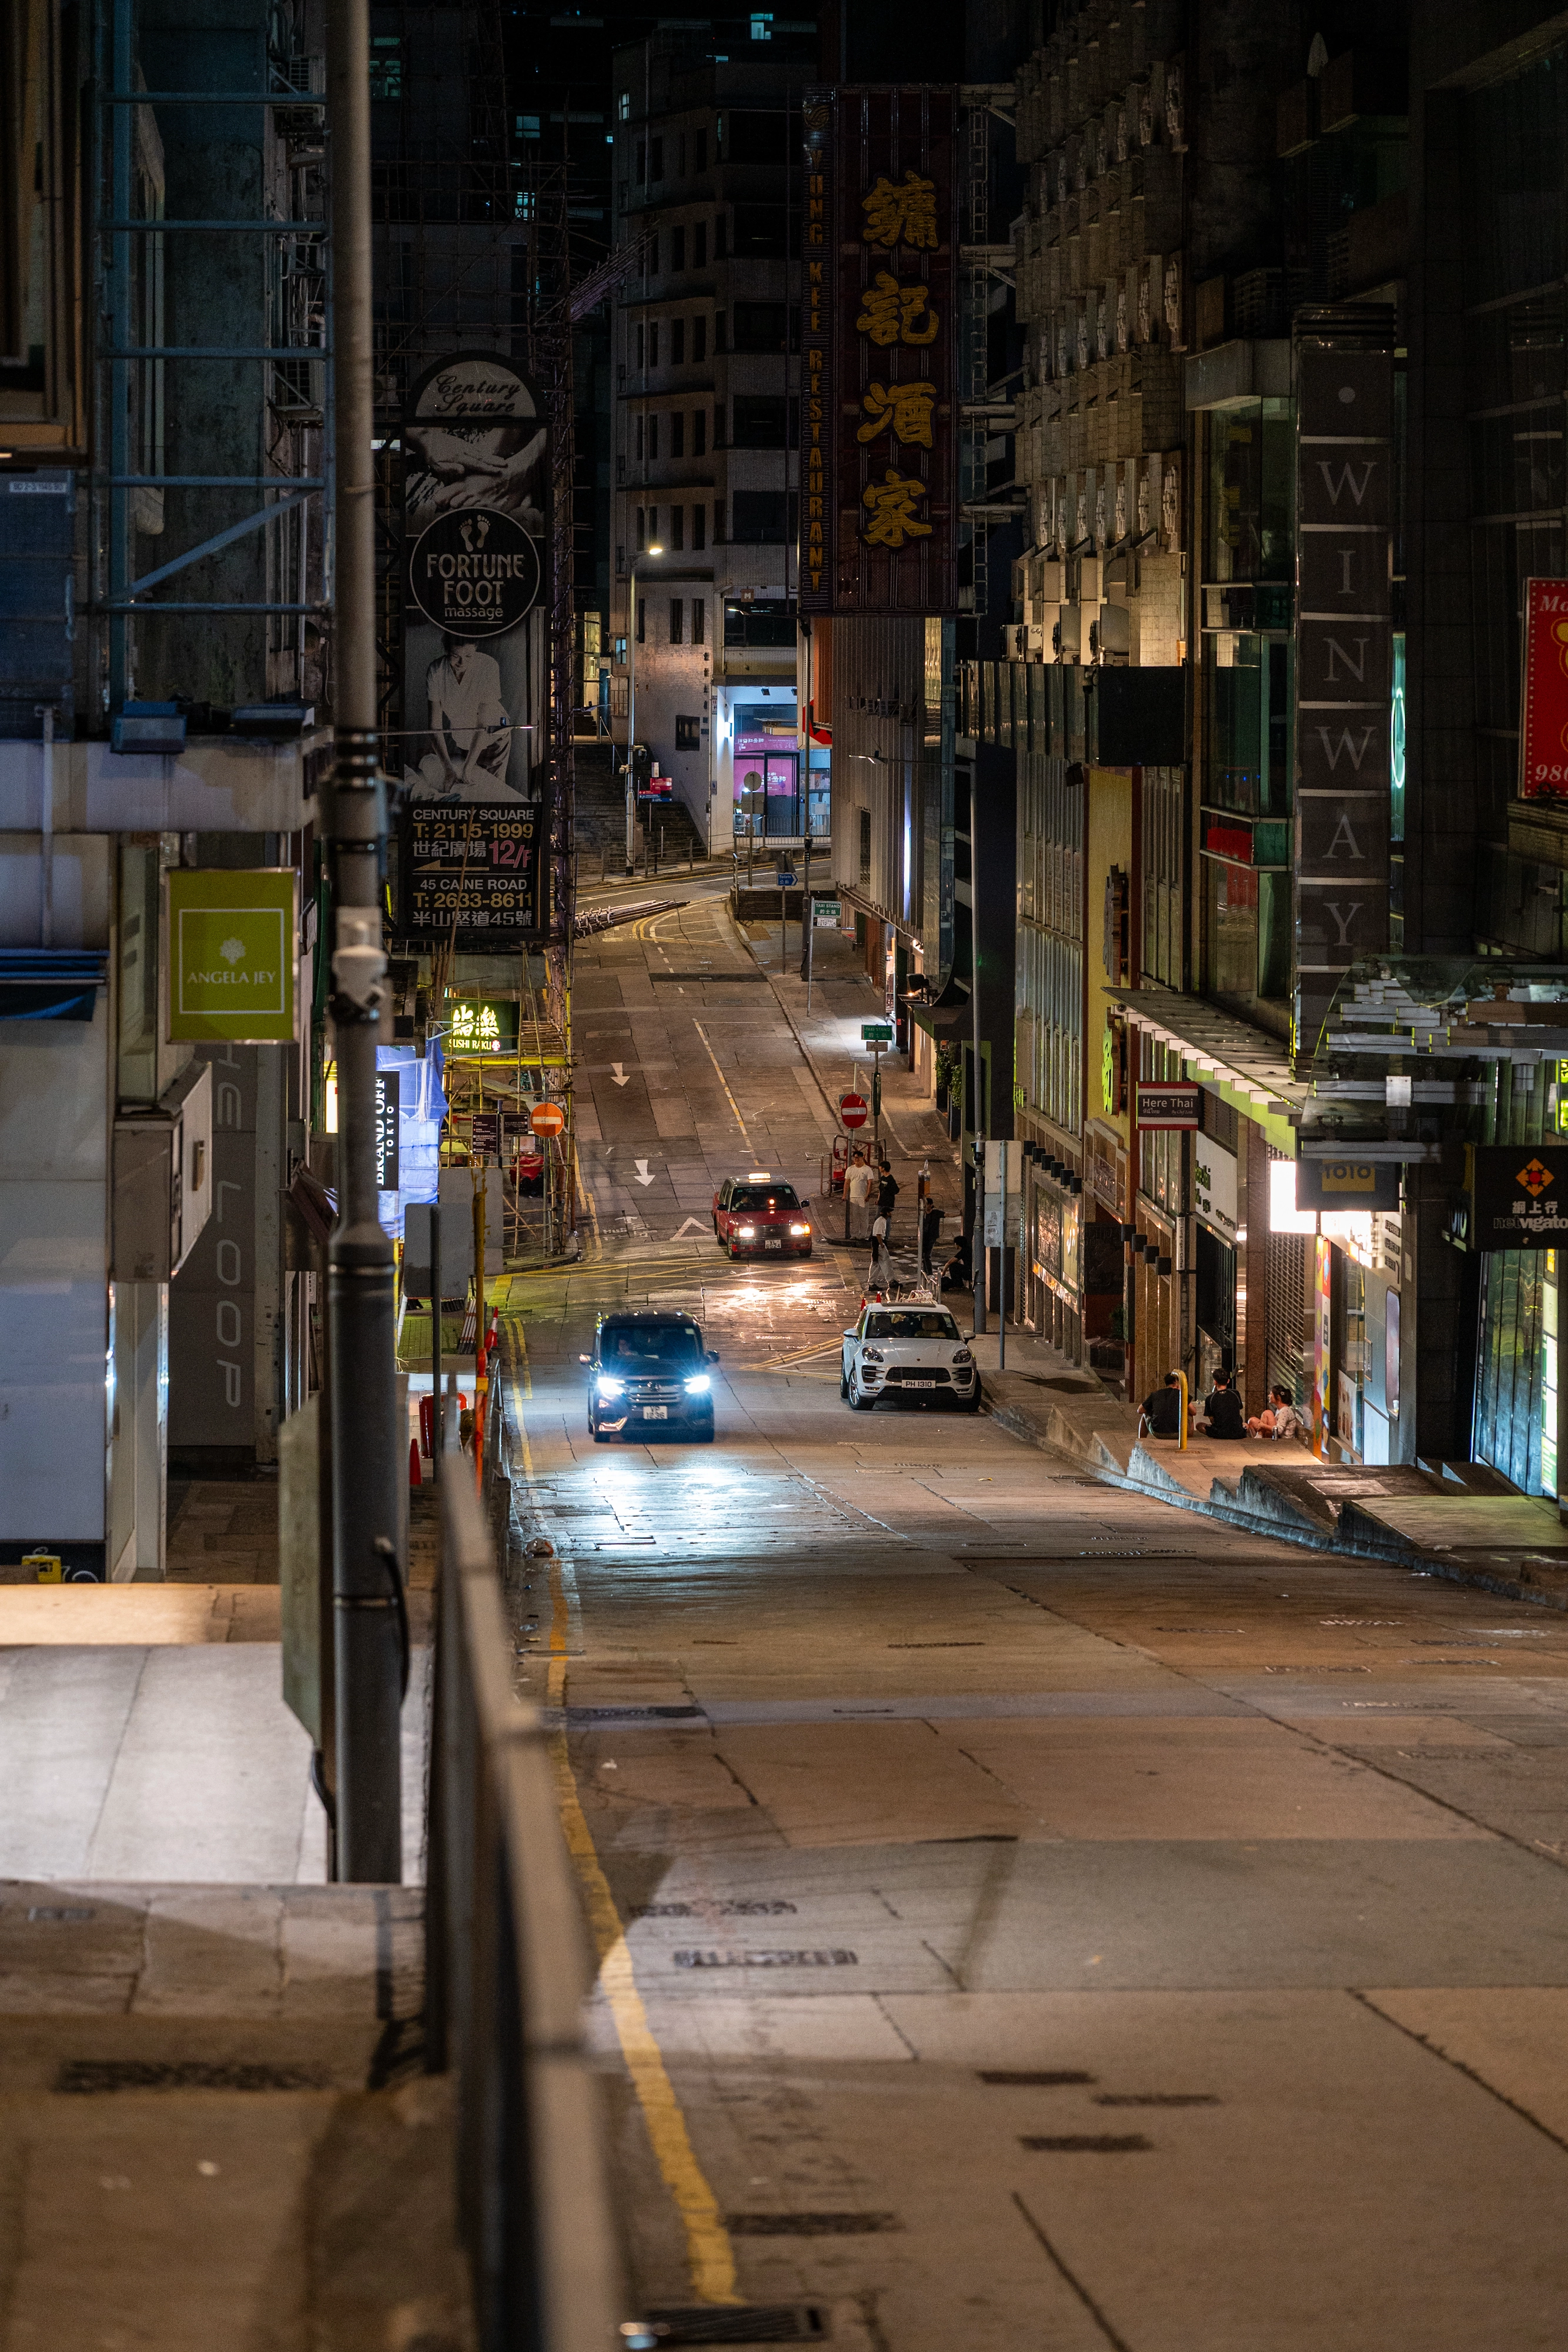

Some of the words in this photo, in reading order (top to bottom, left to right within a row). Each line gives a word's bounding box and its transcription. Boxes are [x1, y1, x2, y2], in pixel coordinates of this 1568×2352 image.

[808, 149, 823, 245] YUNG
[808, 262, 823, 332] KEE
[436, 375, 521, 400] Century
[436, 393, 516, 417] Square
[808, 349, 823, 592] RESTAURANT
[427, 553, 524, 578] FORTUNE
[444, 580, 504, 605] FOOT
[444, 606, 504, 620] massage
[413, 810, 477, 820] CENTURY
[479, 810, 534, 821] SQUARE
[413, 823, 429, 838] T:
[434, 824, 534, 838] 2115-1999
[412, 841, 487, 857] 世紀廣場
[420, 880, 436, 890] 45
[487, 880, 527, 890] ROAD
[413, 893, 429, 907] T:
[434, 893, 531, 908] 2633-8611
[188, 971, 250, 984] ANGELA
[253, 971, 278, 985] JEY
[449, 1038, 470, 1048] SUSHI
[217, 1044, 242, 1130] HE
[1142, 1098, 1168, 1107] Here
[1170, 1098, 1193, 1108] Thai
[386, 1105, 394, 1157] TOKYO
[1512, 1201, 1558, 1214] 網上行
[217, 1180, 242, 1408] LOOP
